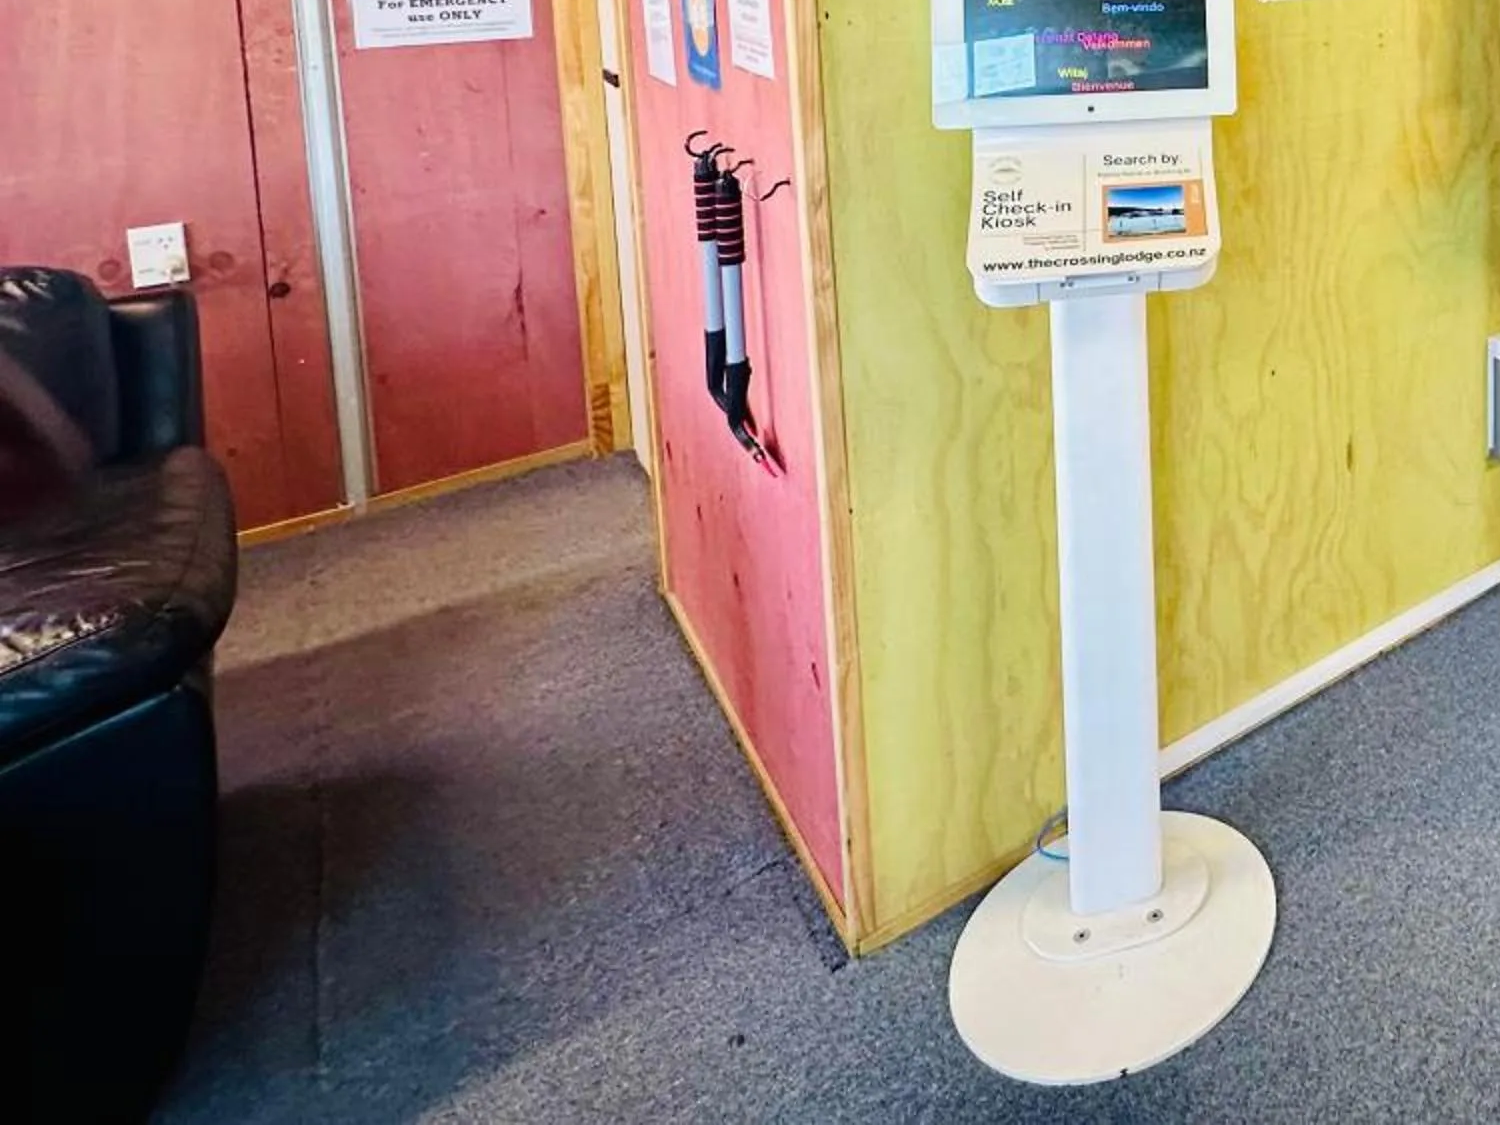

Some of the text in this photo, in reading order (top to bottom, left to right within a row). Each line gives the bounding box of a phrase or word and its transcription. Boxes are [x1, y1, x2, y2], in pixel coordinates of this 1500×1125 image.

[377, 0, 404, 9] For
[1101, 2, 1165, 15] Bem-vindo
[407, 9, 482, 22] use ONLY
[1102, 154, 1158, 167] Search
[983, 189, 1025, 203] Self
[982, 201, 1073, 217] Check-in
[981, 215, 1037, 230] Kiosk
[982, 246, 1207, 273] www.thecrossinglodge.co.nz
